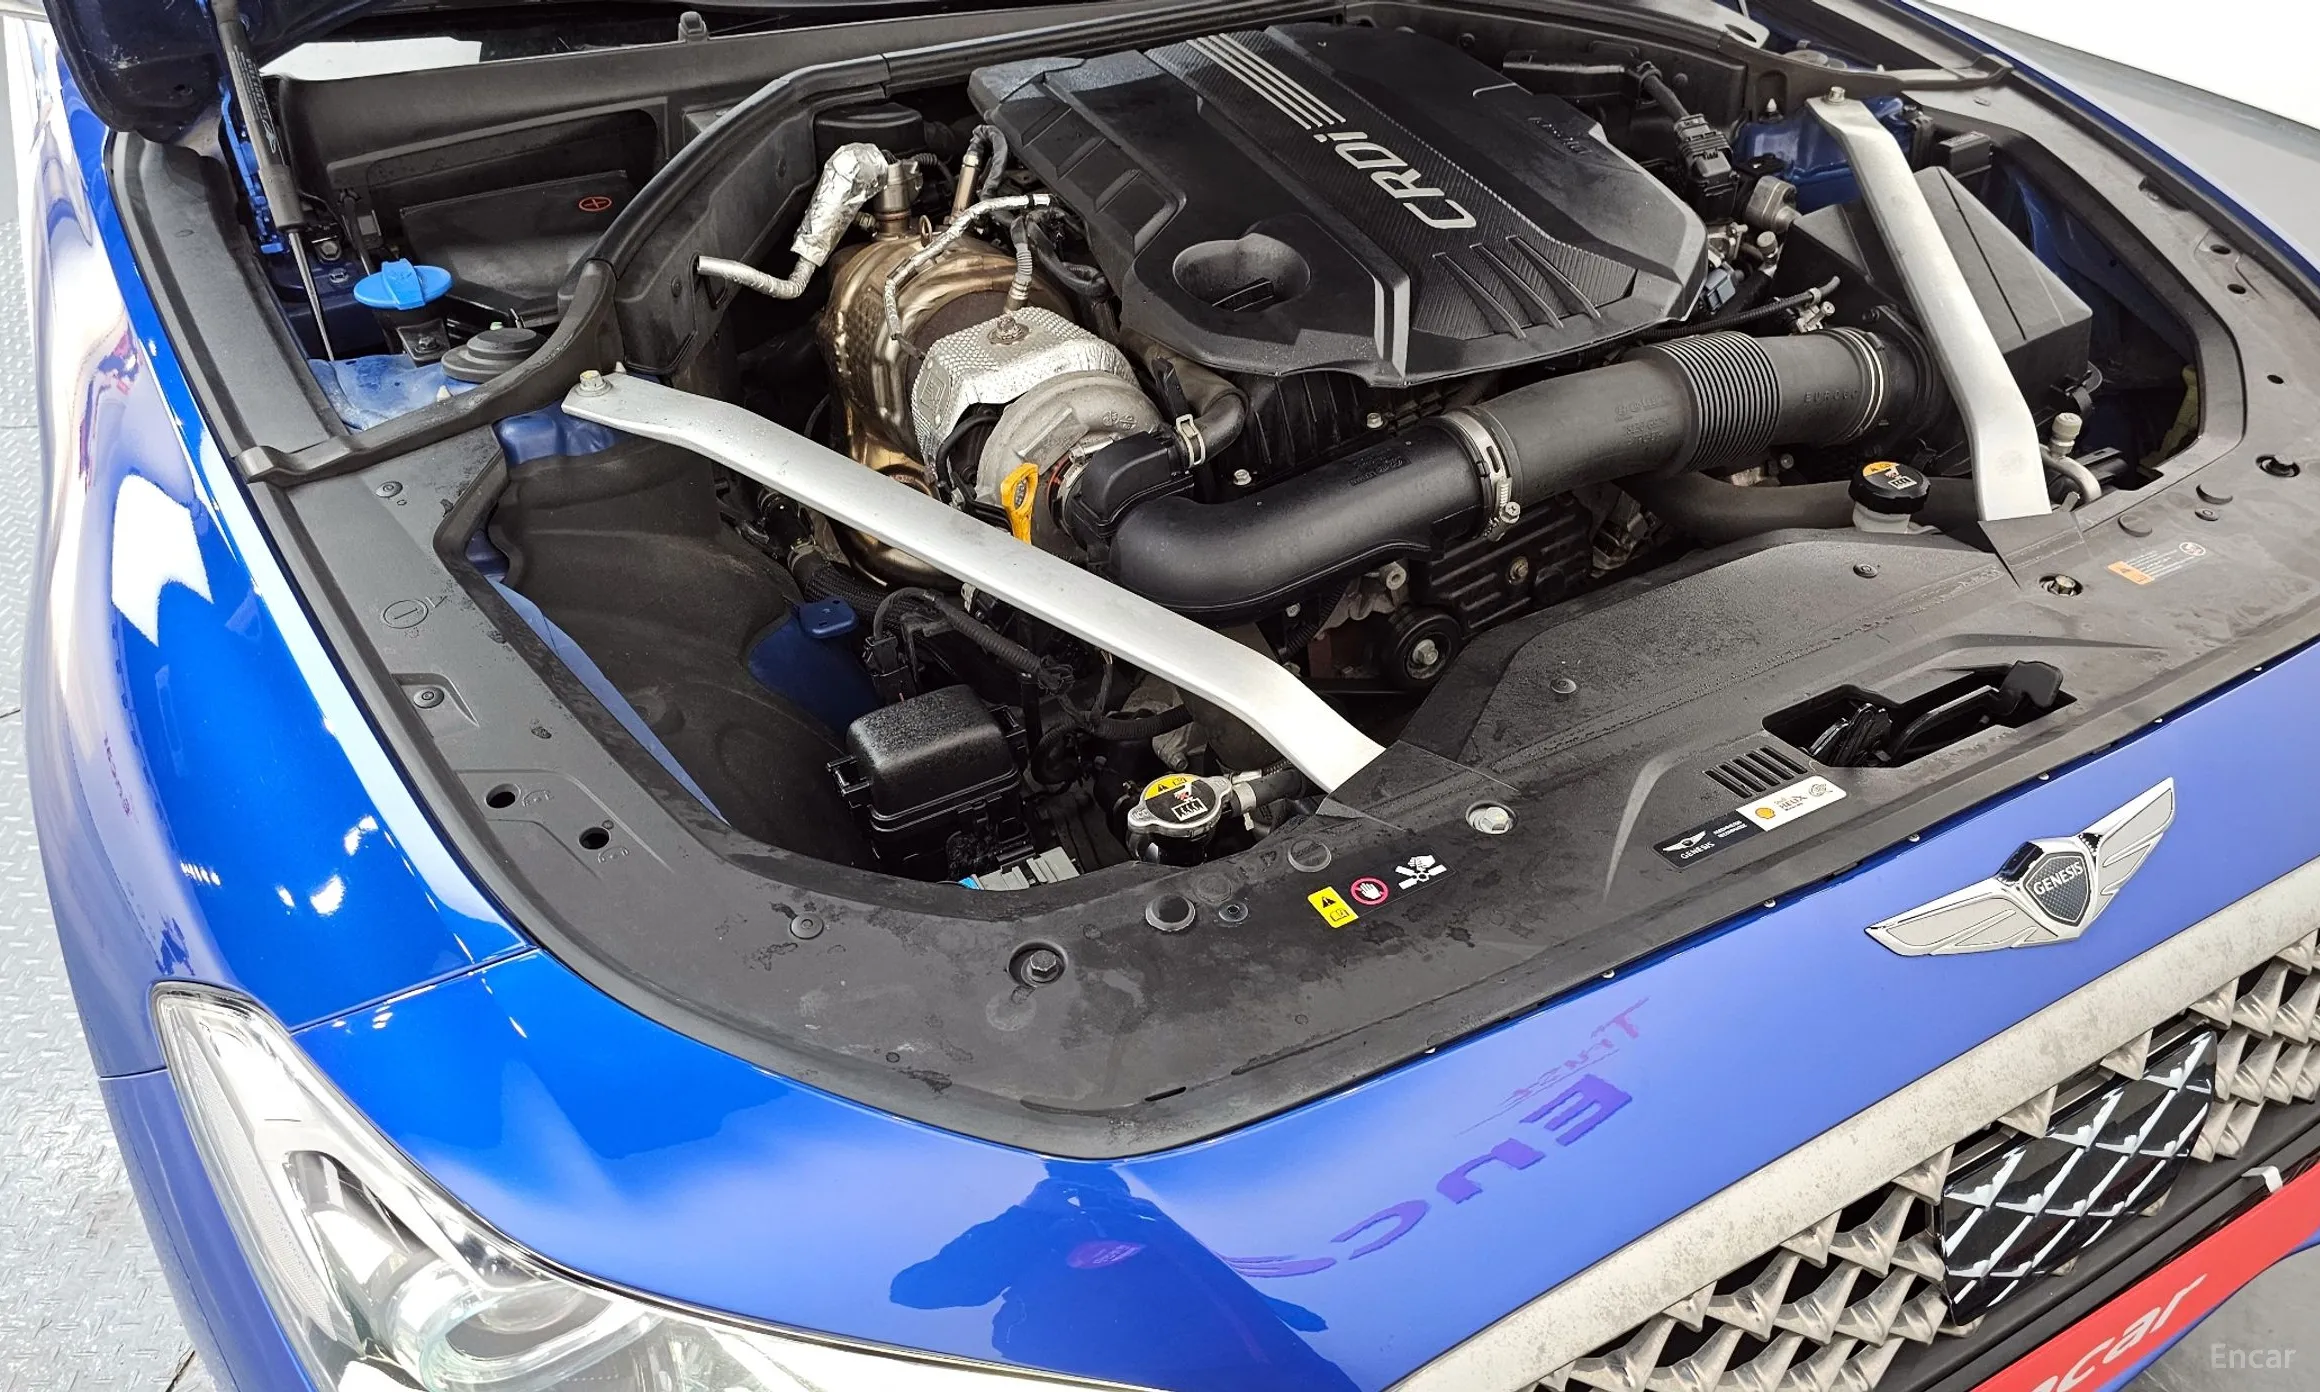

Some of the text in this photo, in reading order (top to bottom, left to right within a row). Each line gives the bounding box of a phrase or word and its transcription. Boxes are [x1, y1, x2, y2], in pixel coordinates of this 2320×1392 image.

[1313, 131, 1477, 230] CRDi
[1680, 841, 1716, 860] GENESIS
[2033, 861, 2084, 895] GENESIS
